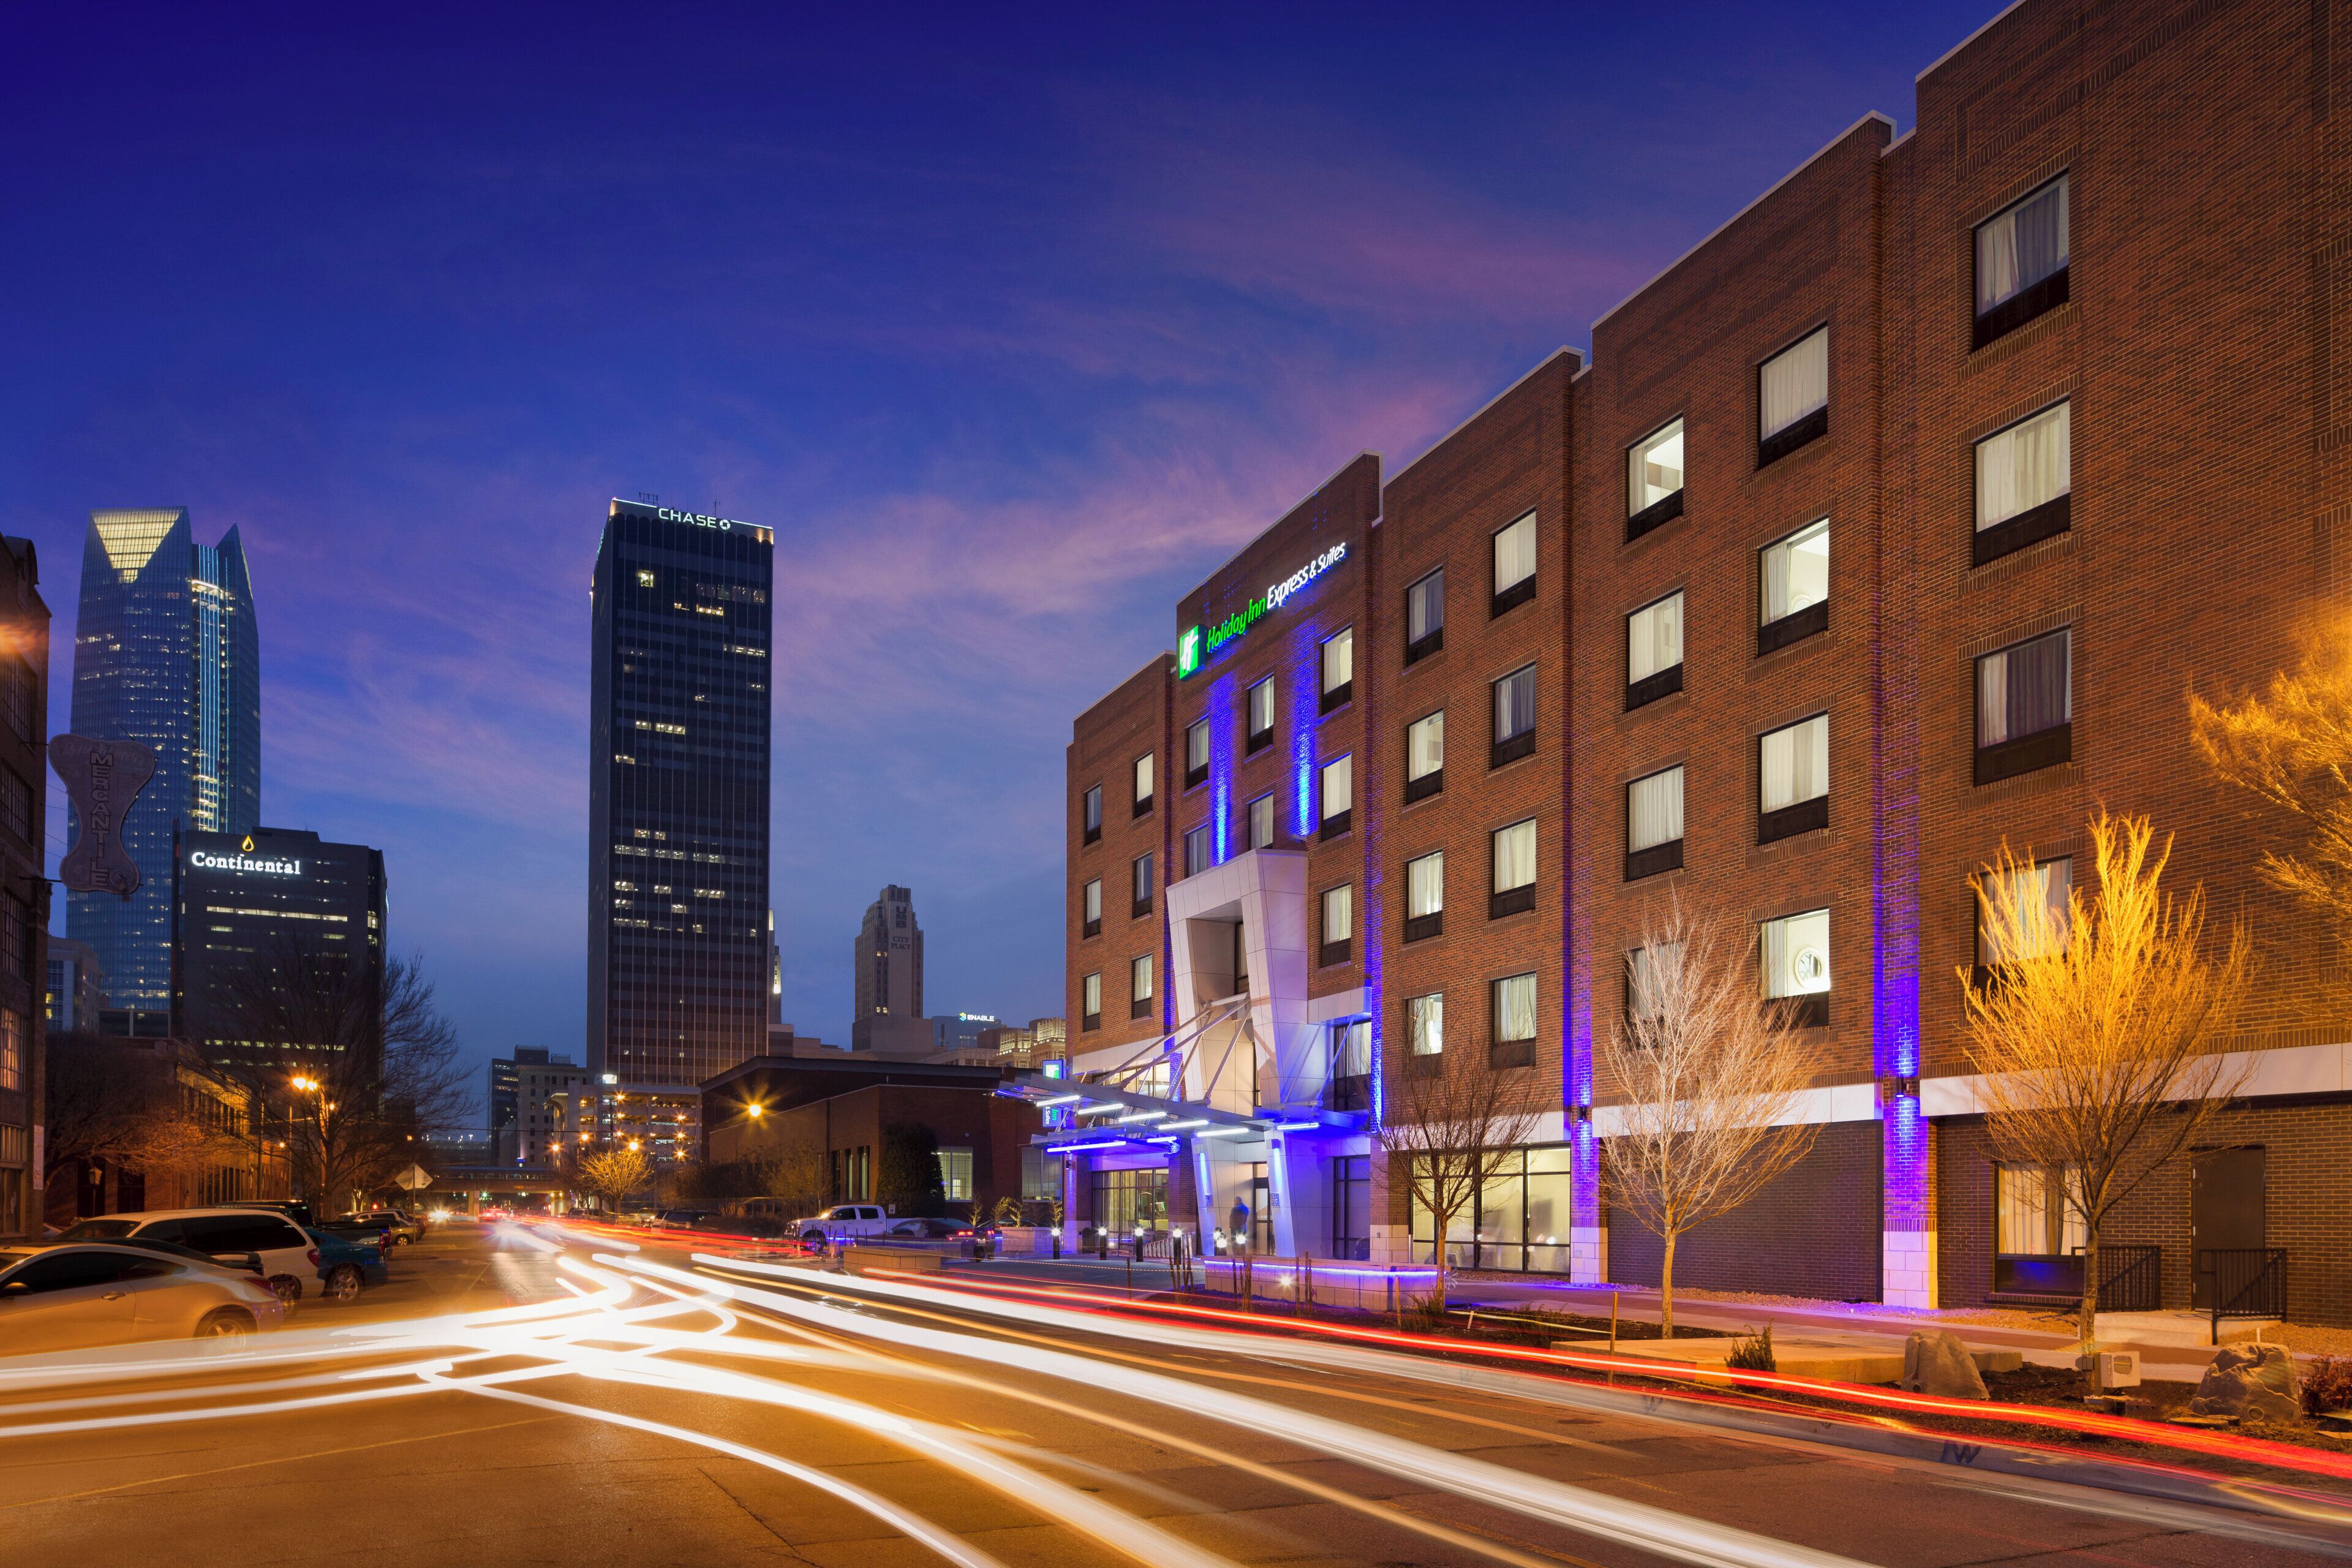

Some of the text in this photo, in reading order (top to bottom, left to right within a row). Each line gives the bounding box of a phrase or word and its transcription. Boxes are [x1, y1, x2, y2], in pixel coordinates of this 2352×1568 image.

[658, 508, 717, 529] CHASE
[1206, 542, 1346, 653] Holiday Inn Express & Suites
[90, 752, 113, 886] MERCANTILE
[191, 851, 301, 875] Continental
